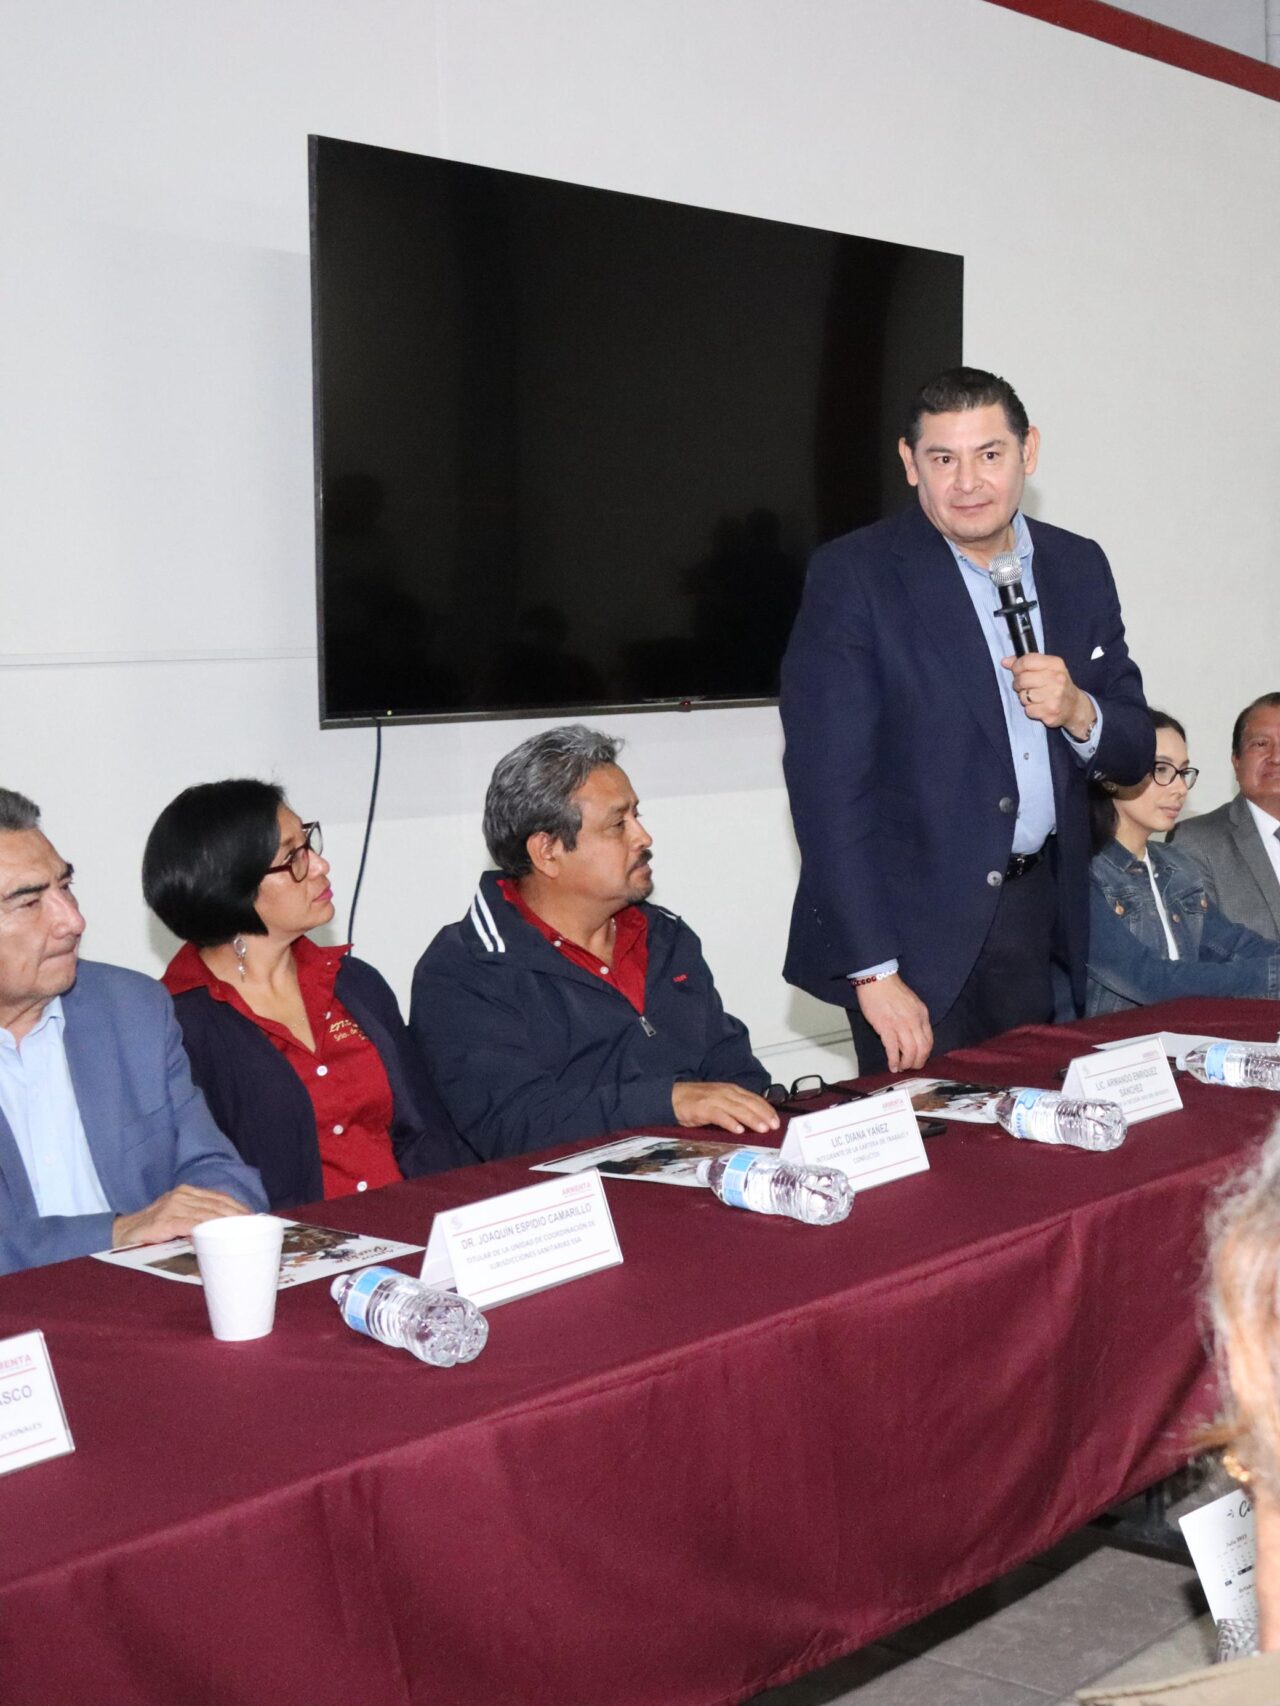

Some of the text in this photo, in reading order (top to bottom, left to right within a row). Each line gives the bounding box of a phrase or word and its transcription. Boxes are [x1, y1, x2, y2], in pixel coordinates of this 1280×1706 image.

[845, 1130, 867, 1144] DIANA
[461, 1202, 593, 1250] DR. JOAQUÍN ESPIDIO CAMARILLO
